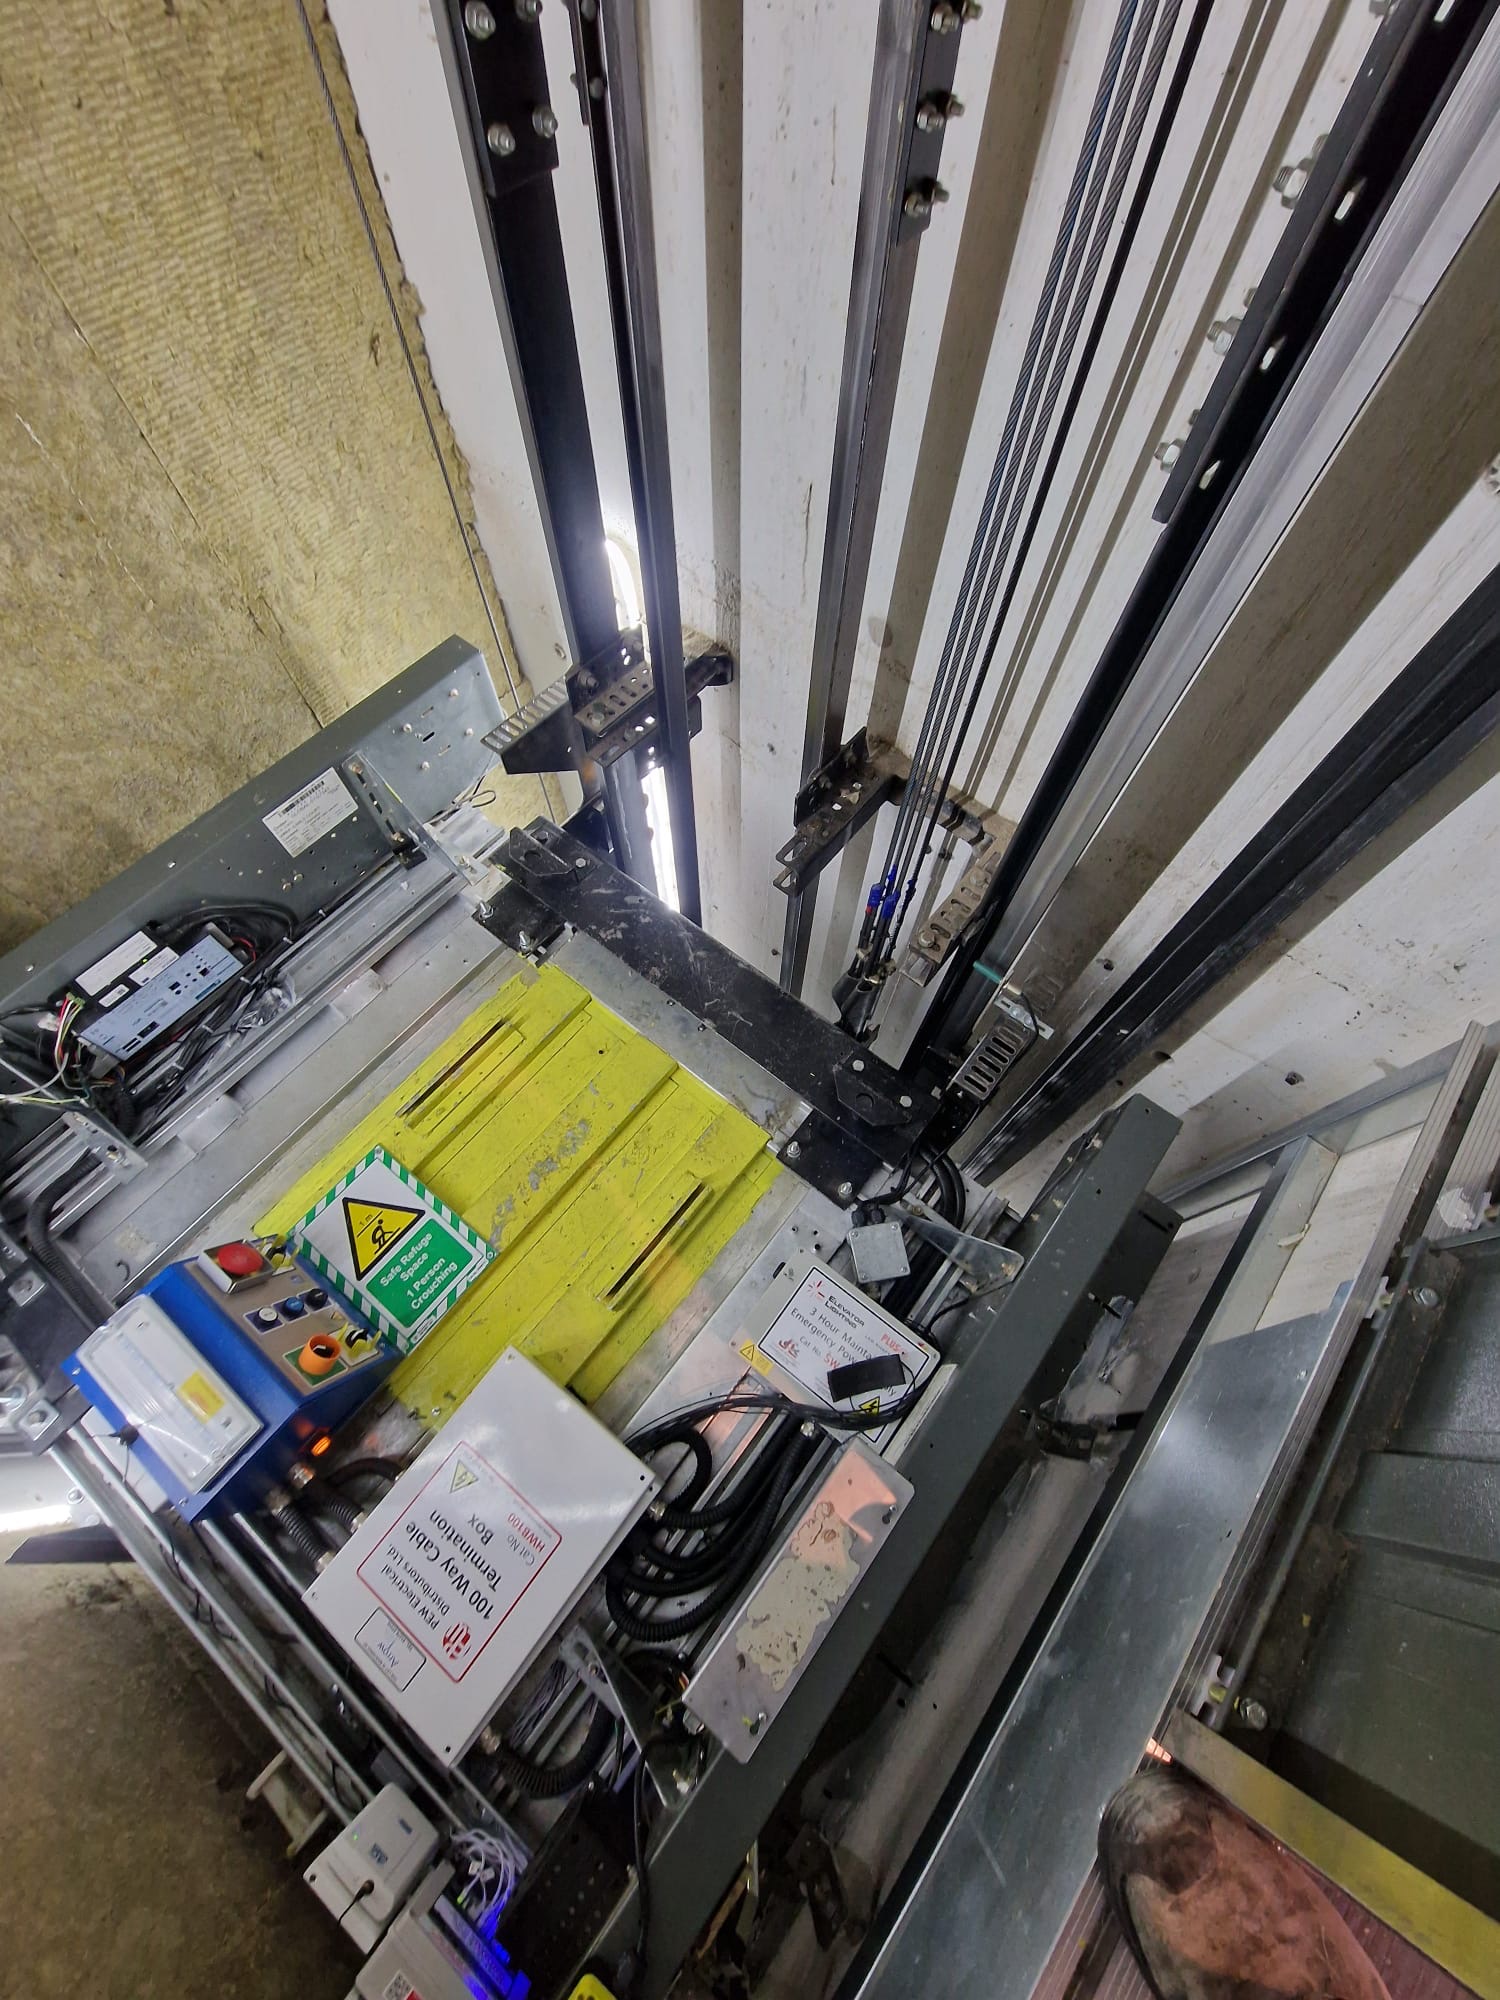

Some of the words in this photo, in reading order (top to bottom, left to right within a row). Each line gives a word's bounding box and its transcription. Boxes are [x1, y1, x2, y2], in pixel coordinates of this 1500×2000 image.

[380, 1265, 402, 1286] Safe
[400, 1233, 433, 1265] Refuge
[400, 1252, 429, 1281] Space
[407, 1289, 415, 1298] 1
[413, 1258, 446, 1291] Person
[411, 1262, 458, 1309] Crouching
[824, 1300, 857, 1329] LIGHTING
[828, 1295, 865, 1327] ELEVATOR
[791, 1307, 836, 1348] Emergency
[837, 1345, 857, 1362] Pow
[810, 1307, 818, 1316] 3
[818, 1313, 839, 1334] Hour
[841, 1332, 873, 1360] Mainta
[405, 1521, 440, 1562] Cable
[467, 1513, 494, 1546] Box
[507, 1512, 546, 1553] HWB100
[429, 1510, 502, 1592] Termination
[519, 1546, 535, 1567] Cat
[381, 1564, 421, 1610] Electrical
[403, 1561, 450, 1616] Distributors
[440, 1556, 470, 1596] Way
[418, 1606, 440, 1631] PEW
[468, 1590, 494, 1620] 100
